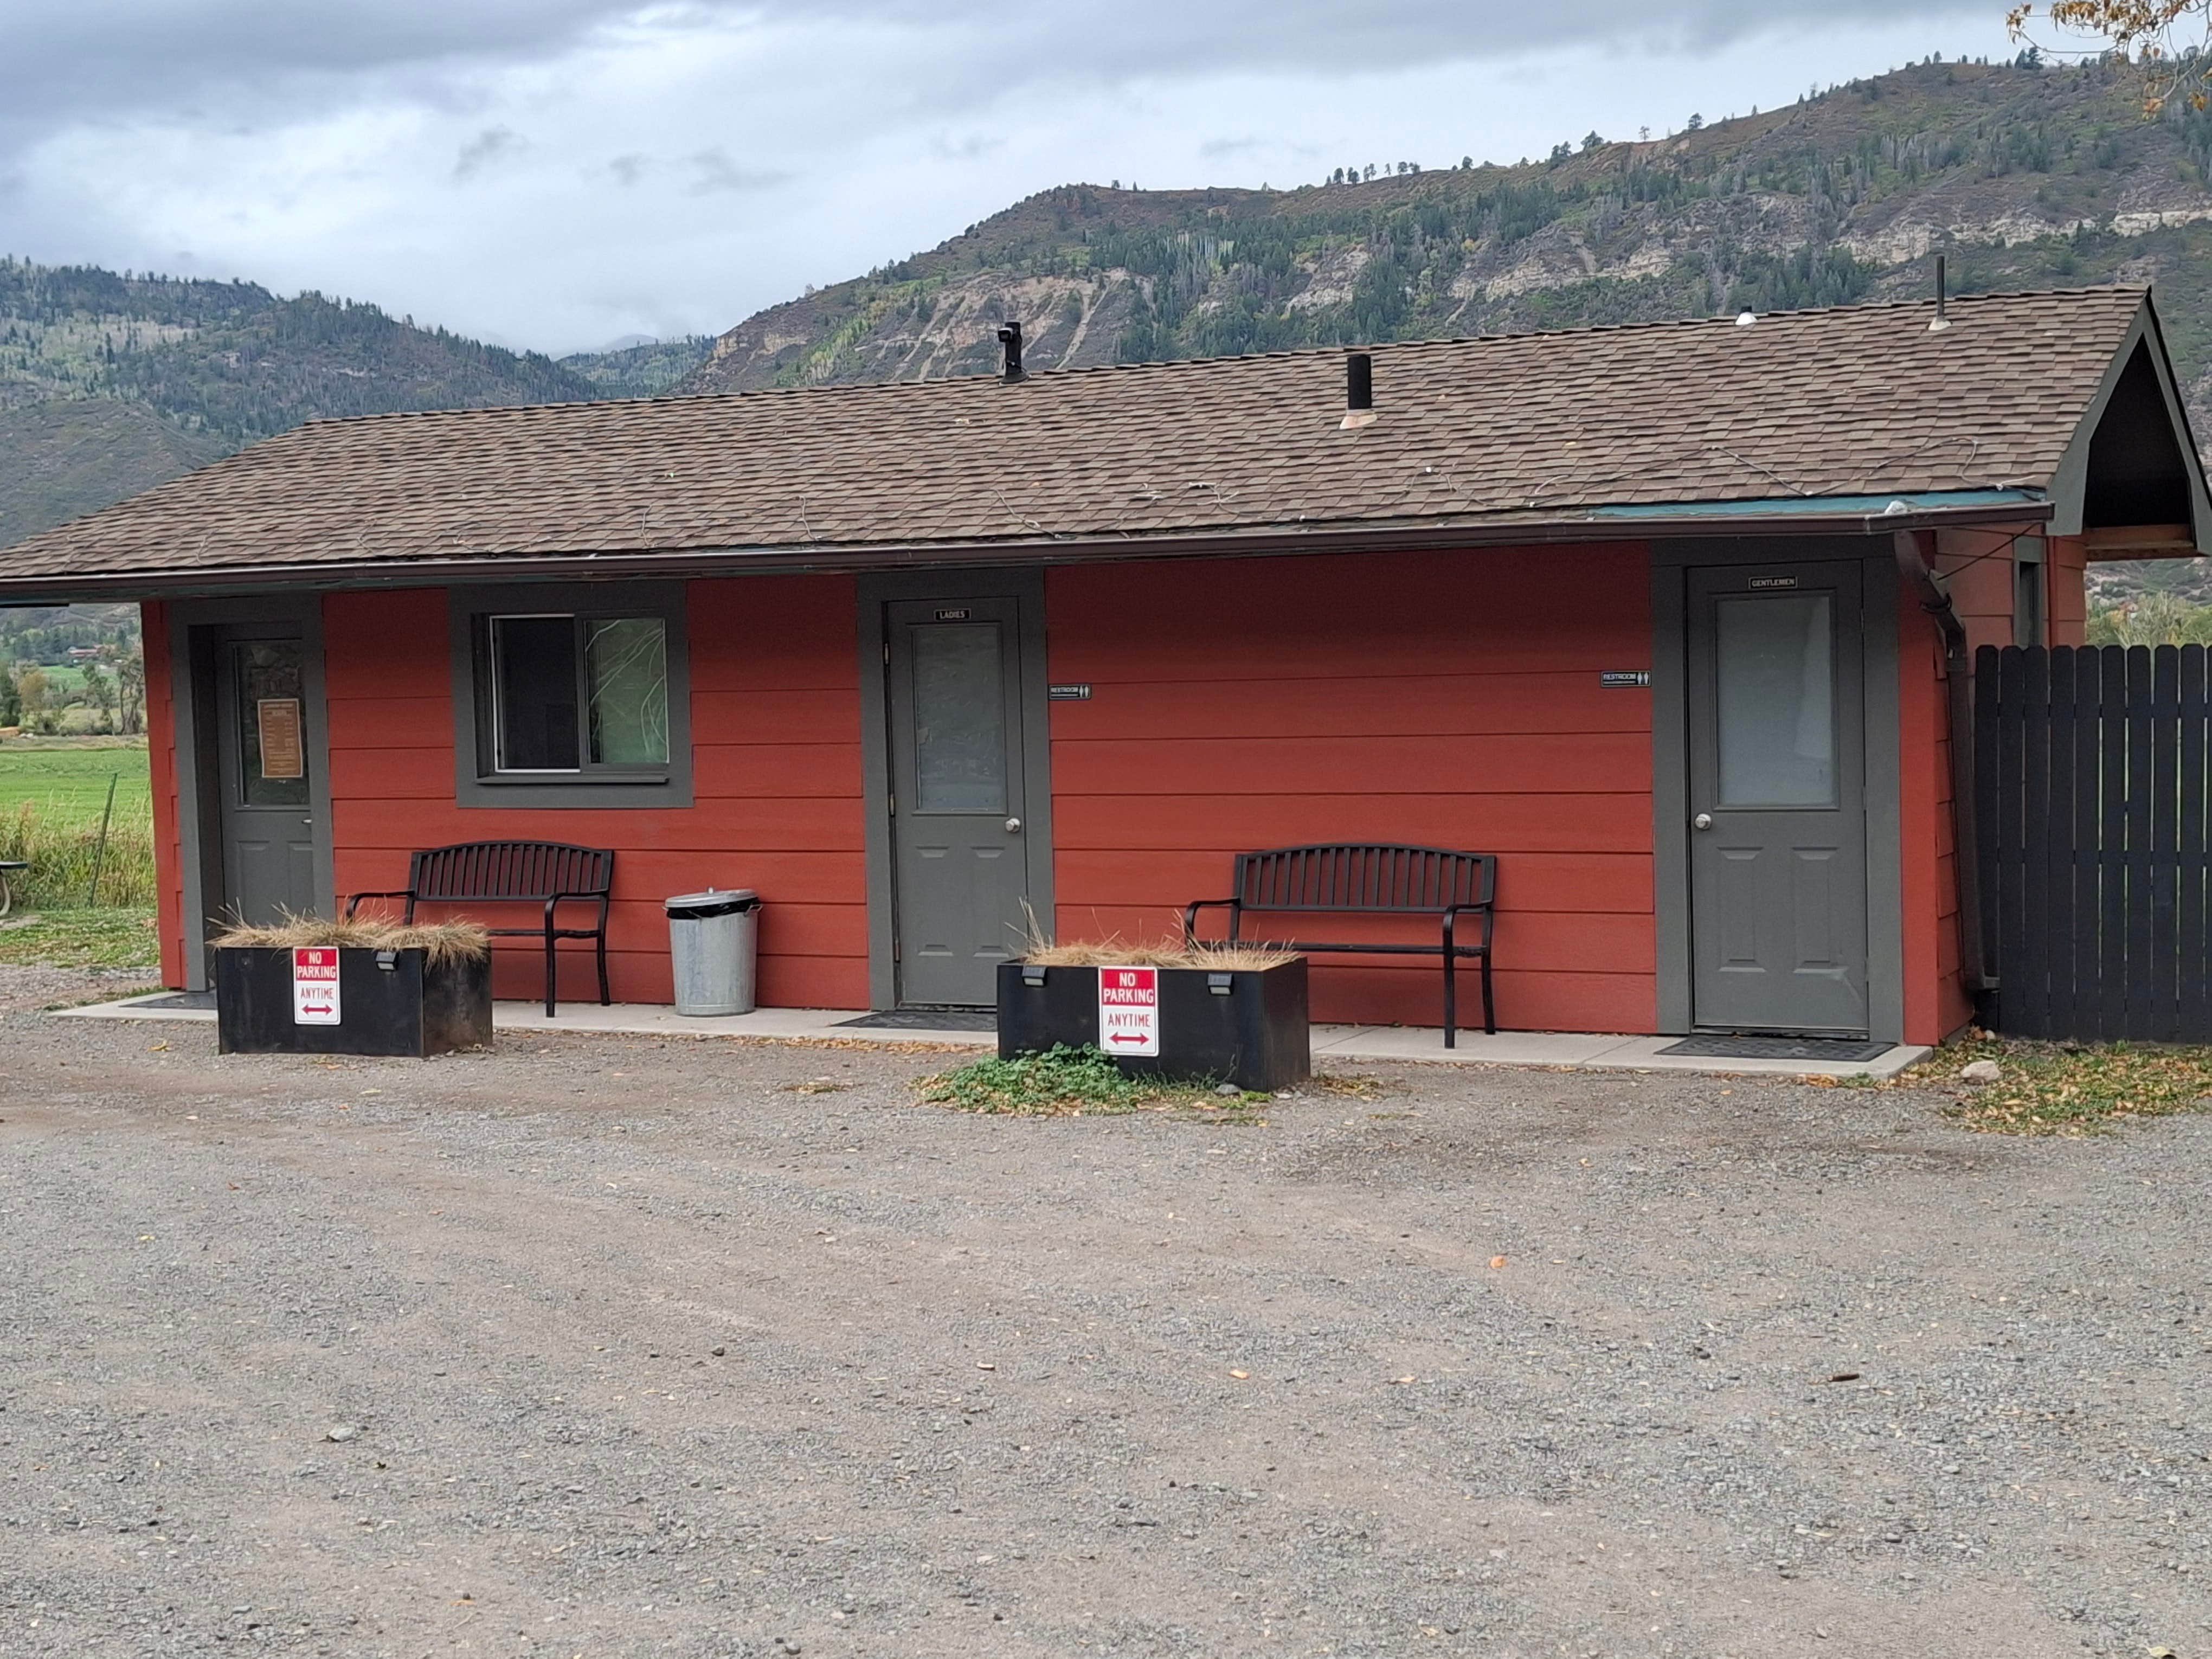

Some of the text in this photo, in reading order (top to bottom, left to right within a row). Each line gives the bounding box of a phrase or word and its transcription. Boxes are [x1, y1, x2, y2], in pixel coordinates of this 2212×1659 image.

[940, 610, 965, 619] LADIES
[308, 951, 322, 964] NO
[297, 966, 336, 979] PARKING
[1119, 972, 1136, 987] NO
[300, 987, 333, 999] ANYTIME
[1103, 988, 1154, 1004] PARKING
[1108, 1013, 1150, 1027] ANYTIME
